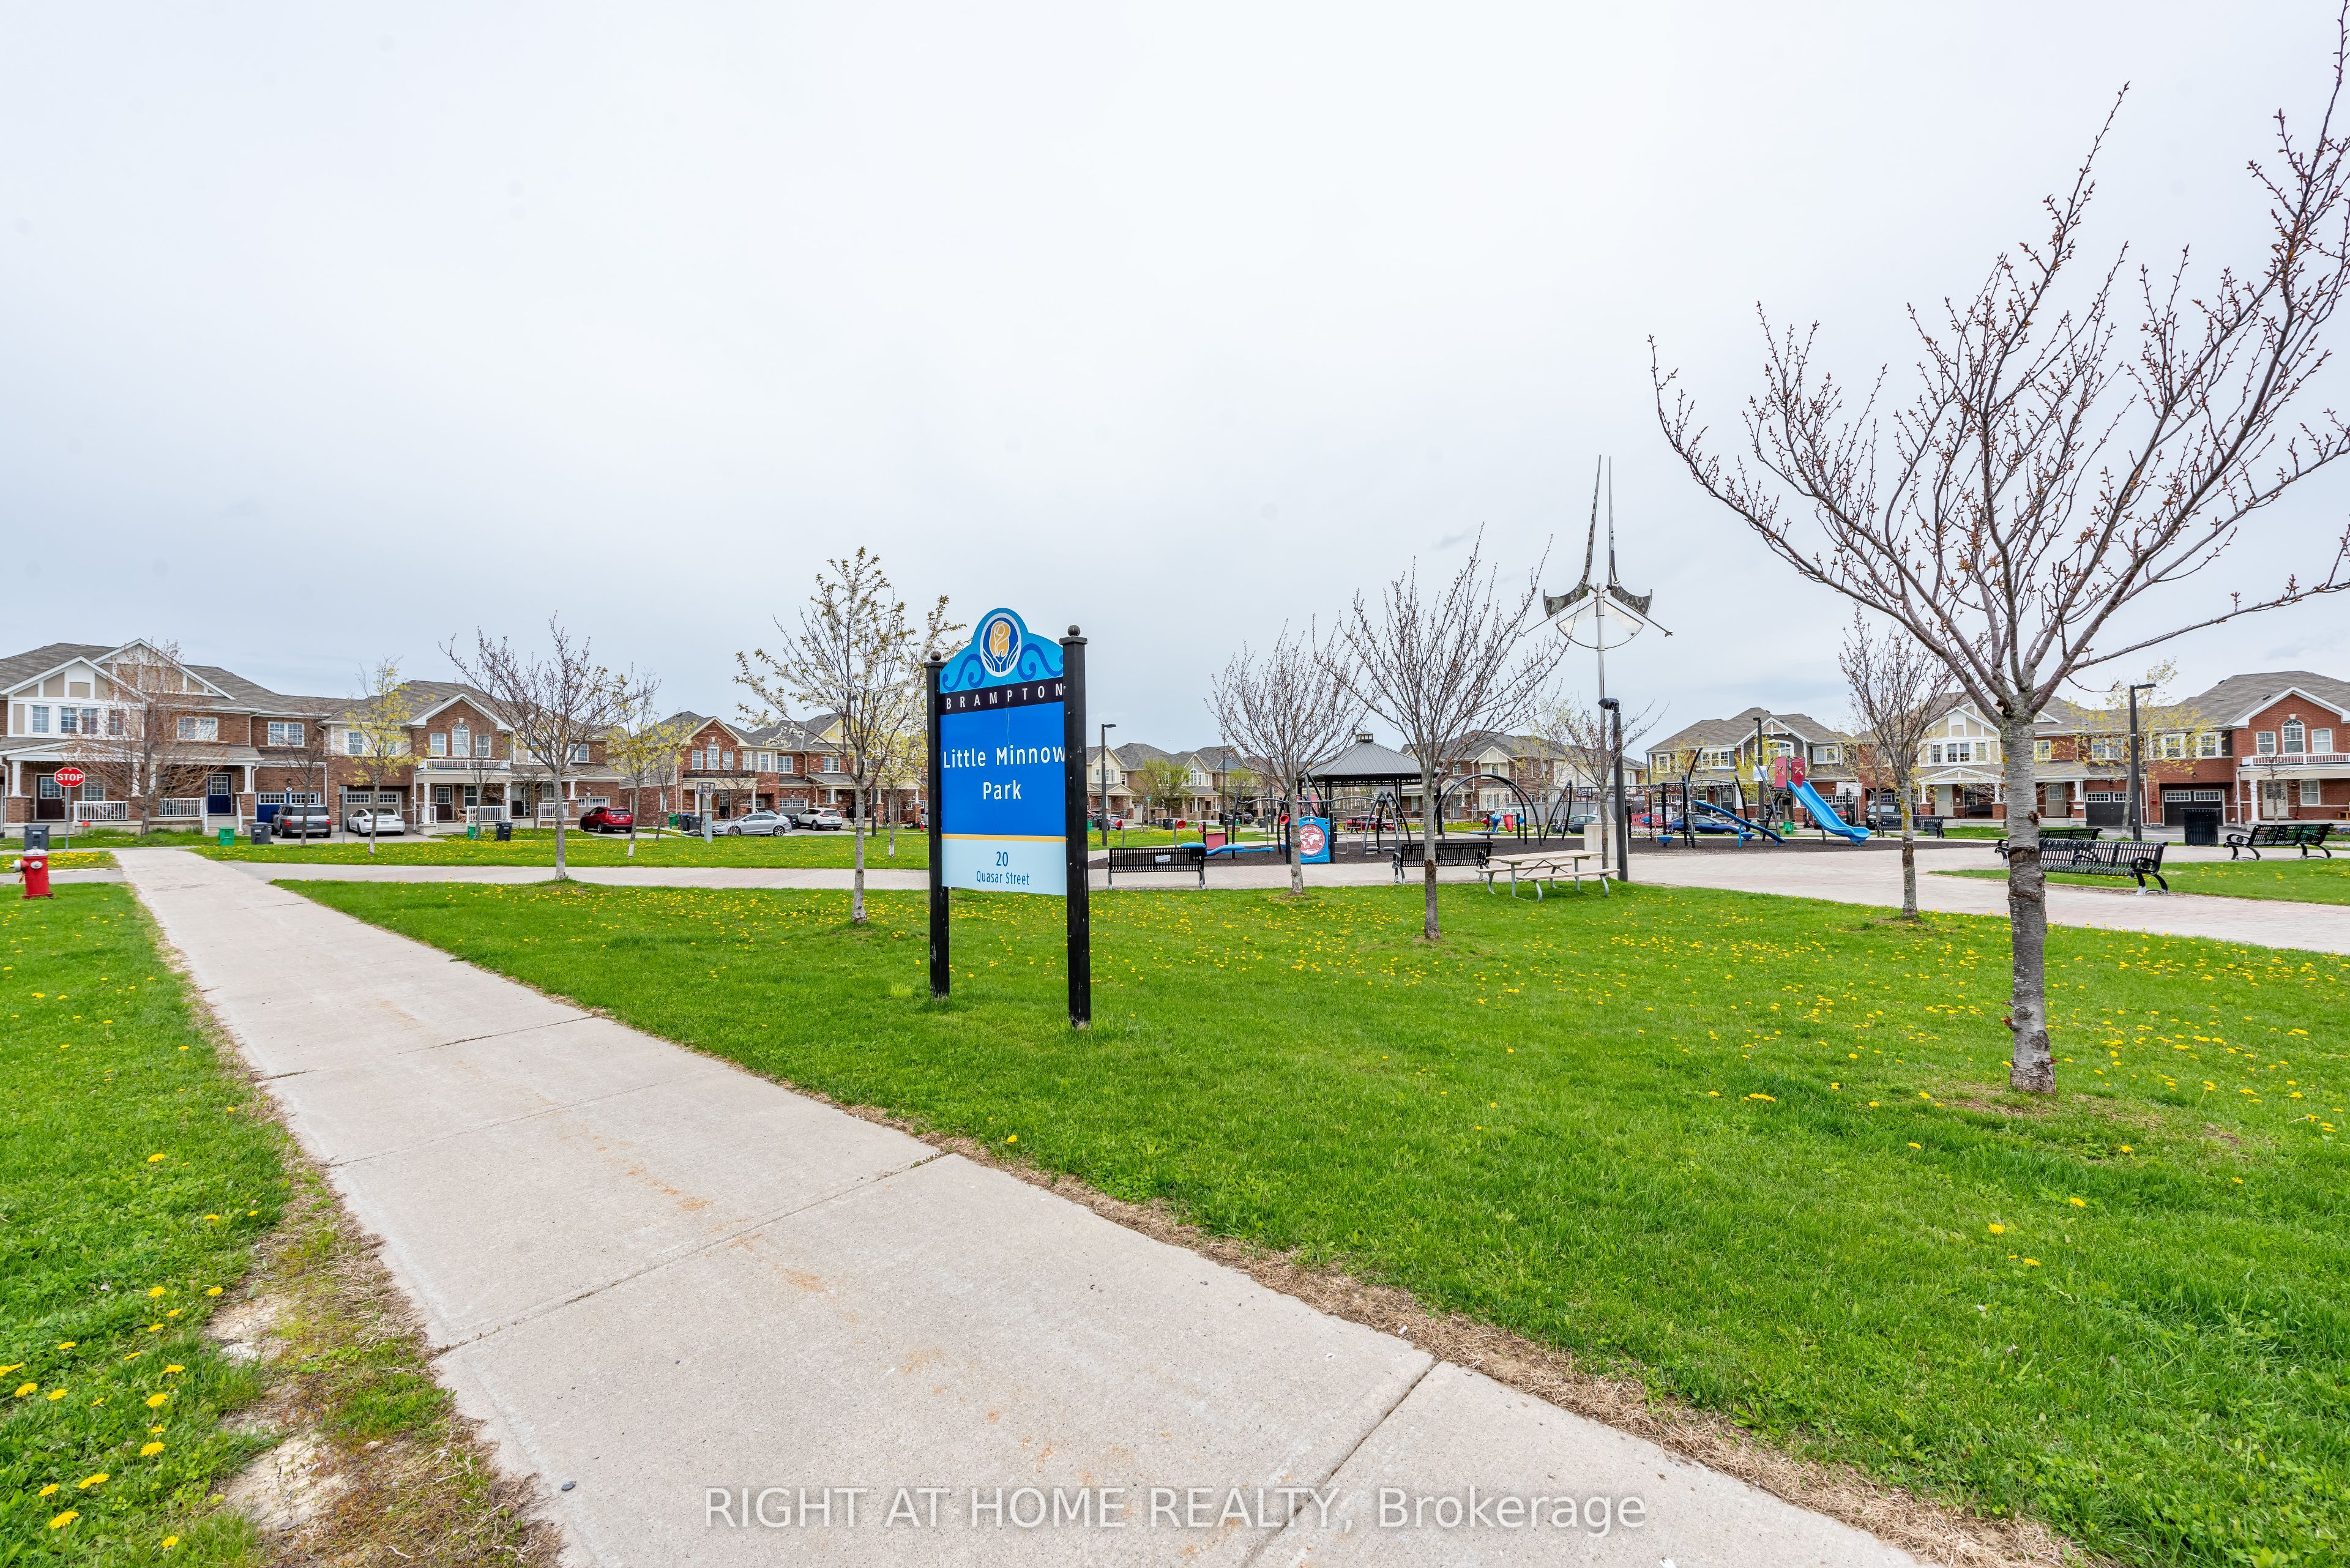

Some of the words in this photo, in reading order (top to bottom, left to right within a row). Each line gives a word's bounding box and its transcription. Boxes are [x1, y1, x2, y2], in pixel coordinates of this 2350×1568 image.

[946, 683, 1063, 709] BRAMPTON
[944, 748, 986, 768] Little
[996, 745, 1065, 766] Minnow
[56, 773, 83, 782] STOP
[983, 779, 1021, 800] Park
[996, 851, 1009, 867] 20
[976, 870, 1002, 883] Quasar
[1005, 872, 1029, 886] Street
